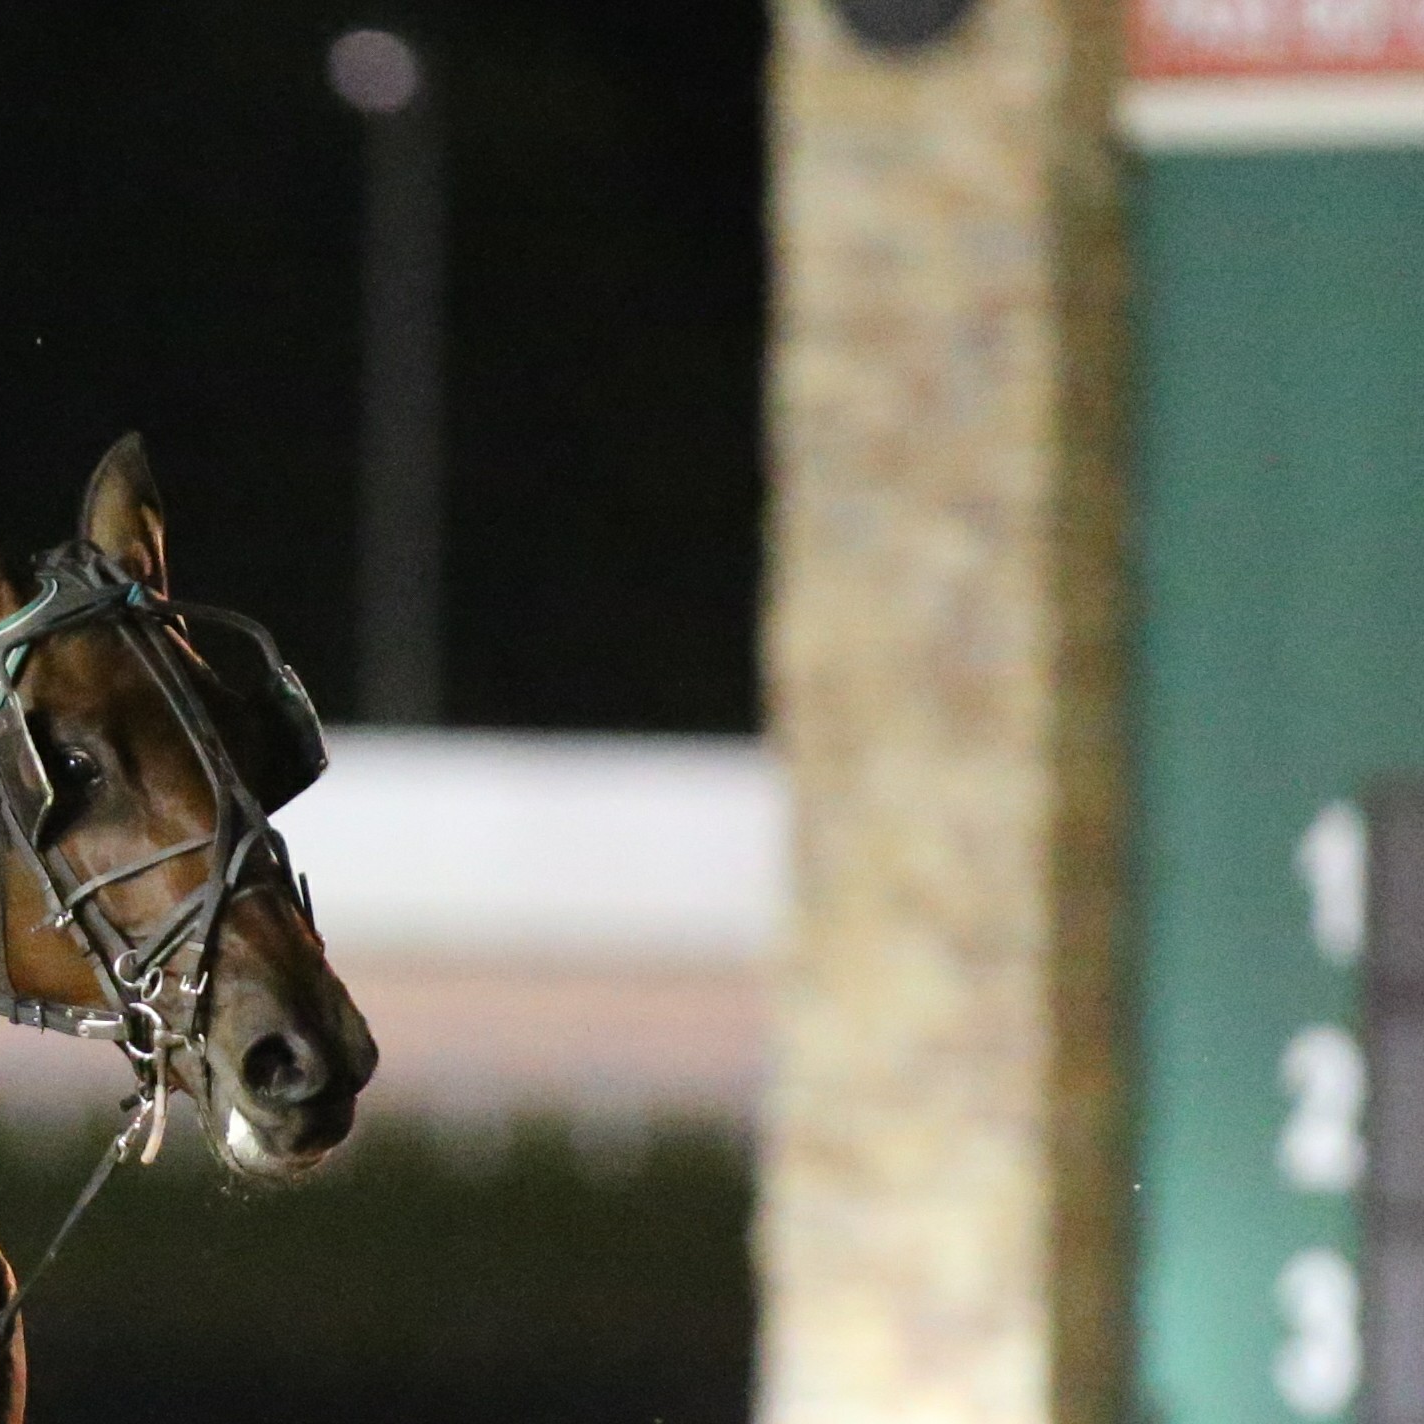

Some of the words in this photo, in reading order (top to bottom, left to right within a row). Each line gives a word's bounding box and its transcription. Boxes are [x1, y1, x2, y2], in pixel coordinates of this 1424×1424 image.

[1298, 806, 1365, 955] 1
[1280, 1029, 1364, 1189] 2
[1274, 1249, 1360, 1415] 3
